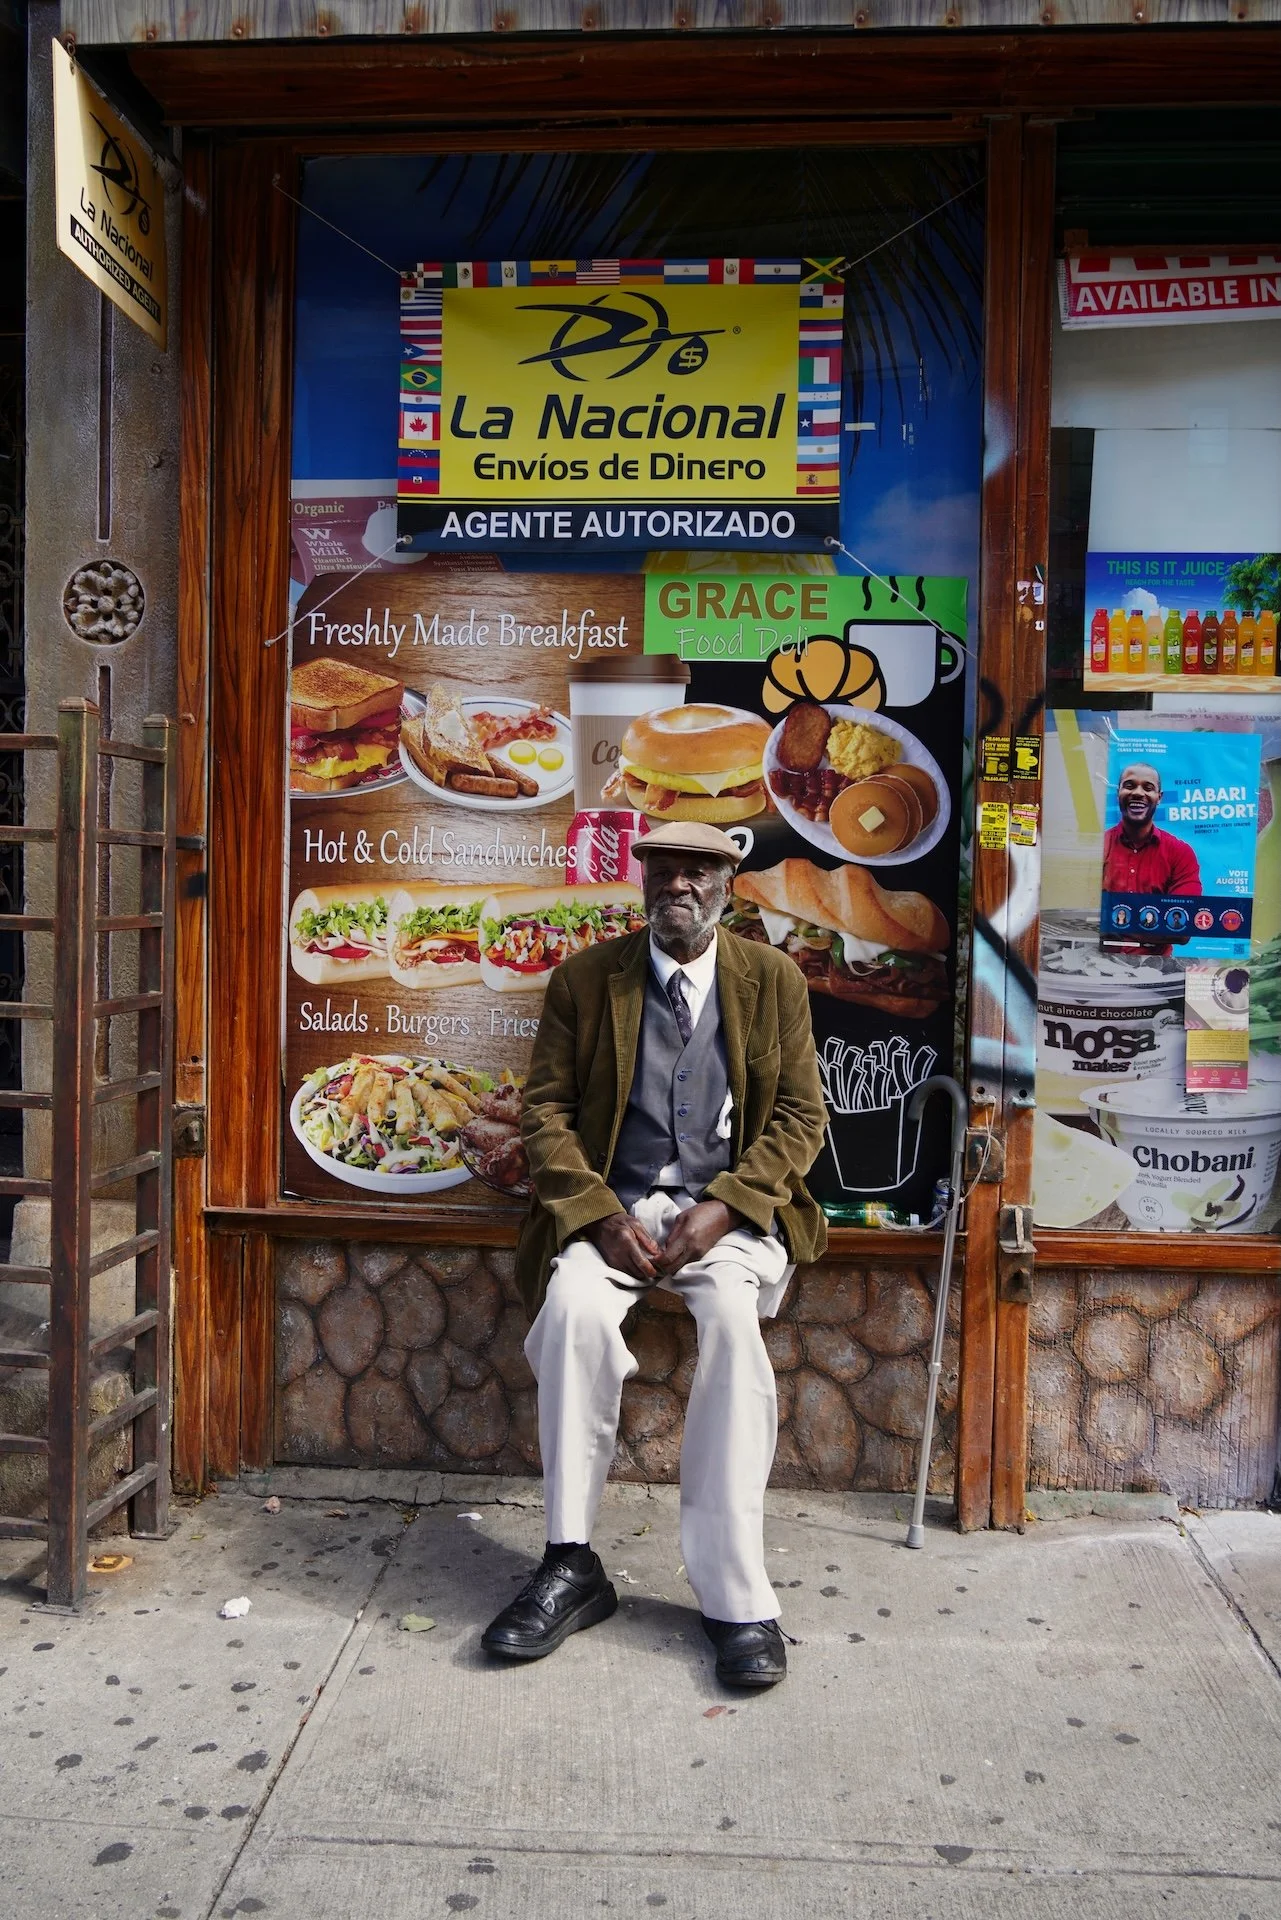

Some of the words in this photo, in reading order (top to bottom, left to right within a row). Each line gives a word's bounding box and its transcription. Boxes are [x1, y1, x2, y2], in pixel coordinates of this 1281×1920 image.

[80, 187, 95, 223] La
[101, 209, 154, 282] Nacional
[74, 223, 131, 290] AUTHORIZED
[133, 287, 159, 318] AGENT
[1075, 280, 1239, 312] AVAILABLE
[1250, 276, 1281, 303] IN
[450, 395, 514, 439] La
[537, 393, 786, 439] Nacional
[474, 453, 589, 480] Envíos
[598, 453, 639, 480] de
[650, 453, 766, 480] Dinero
[294, 501, 345, 517] Organic
[440, 511, 572, 539] AGENTE
[581, 510, 796, 539] AUTORIZADO
[309, 547, 349, 556] Milk
[1107, 561, 1141, 575] THIS
[1145, 561, 1159, 575] IS
[1163, 561, 1177, 575] IT
[1181, 561, 1225, 576] JUICE
[658, 581, 829, 621] GRACE
[308, 608, 406, 658] Freshly
[412, 608, 489, 648] Made
[499, 608, 629, 659] Breakfast
[675, 623, 743, 659] Food
[754, 626, 809, 656] Deli
[1182, 786, 1246, 803] JABARI
[1169, 804, 1256, 821] BRISPORT
[304, 829, 347, 864] Hot
[347, 830, 375, 864] &
[380, 825, 435, 866] Cold
[441, 828, 578, 868] Sandwiches
[1228, 870, 1249, 878] VOTE
[299, 998, 369, 1033] Salads
[386, 1004, 471, 1046] Burgers
[489, 1007, 541, 1038] Fries
[1056, 1006, 1097, 1018] almond
[1100, 1009, 1154, 1018] chocolate
[1043, 1019, 1157, 1059] noosa
[1072, 1059, 1131, 1072] mates
[1145, 1127, 1179, 1135] LOCALLY
[1133, 1145, 1255, 1172] Chobani
[1151, 1174, 1172, 1182] Yogurt
[1173, 1175, 1201, 1184] Blended
